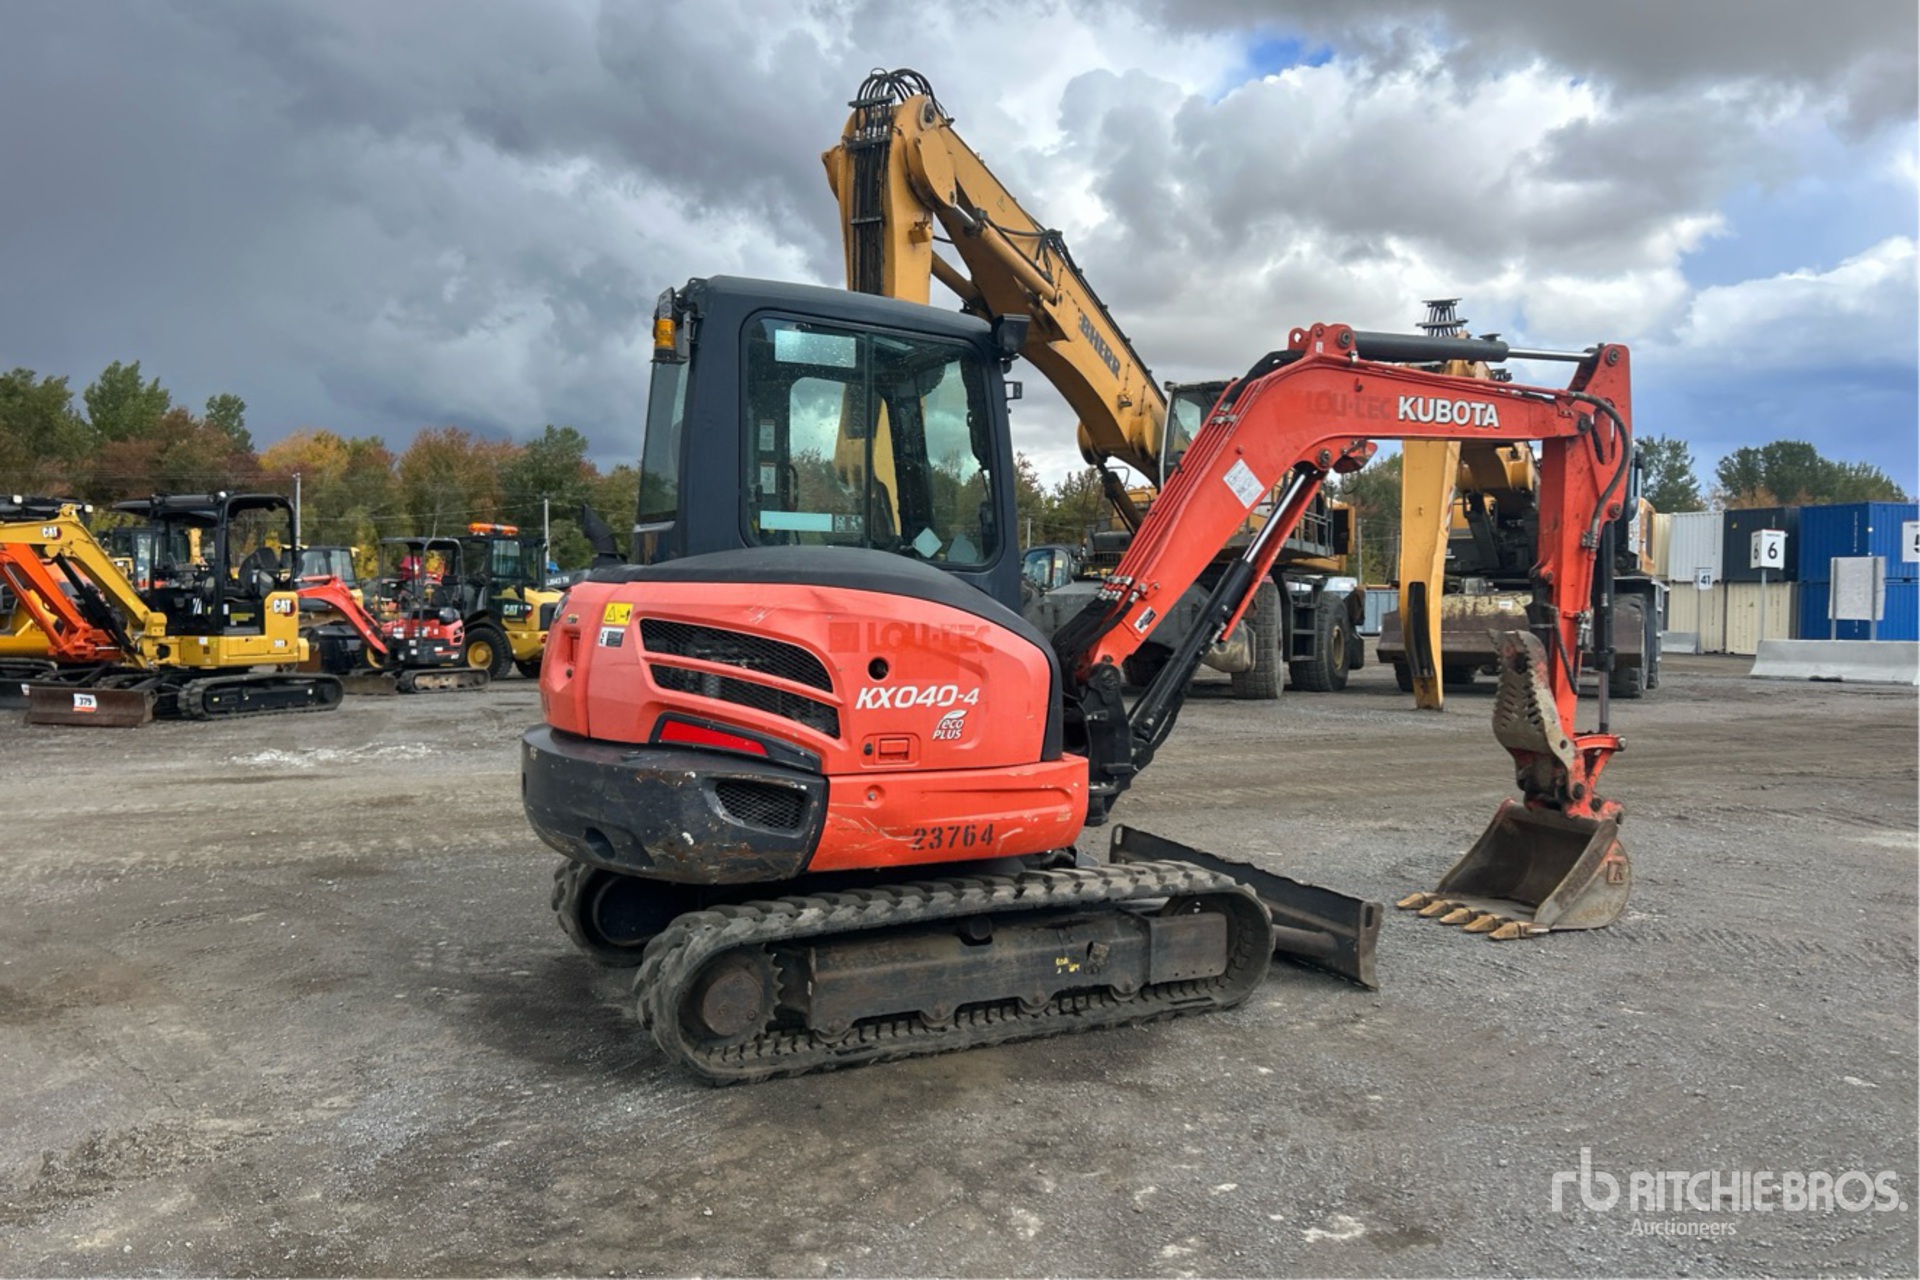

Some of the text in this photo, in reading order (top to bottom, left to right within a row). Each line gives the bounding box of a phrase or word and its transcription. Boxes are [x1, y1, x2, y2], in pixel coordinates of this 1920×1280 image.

[1398, 396, 1500, 428] KUBOTA
[42, 526, 58, 538] CAT
[1767, 541, 1778, 559] 6
[1700, 574, 1711, 585] 41
[273, 599, 291, 613] CAT
[503, 604, 519, 616] CAT
[855, 685, 980, 710] KX040-4
[941, 718, 965, 730] eco
[932, 729, 962, 740] PLUS
[912, 823, 994, 851] 23764
